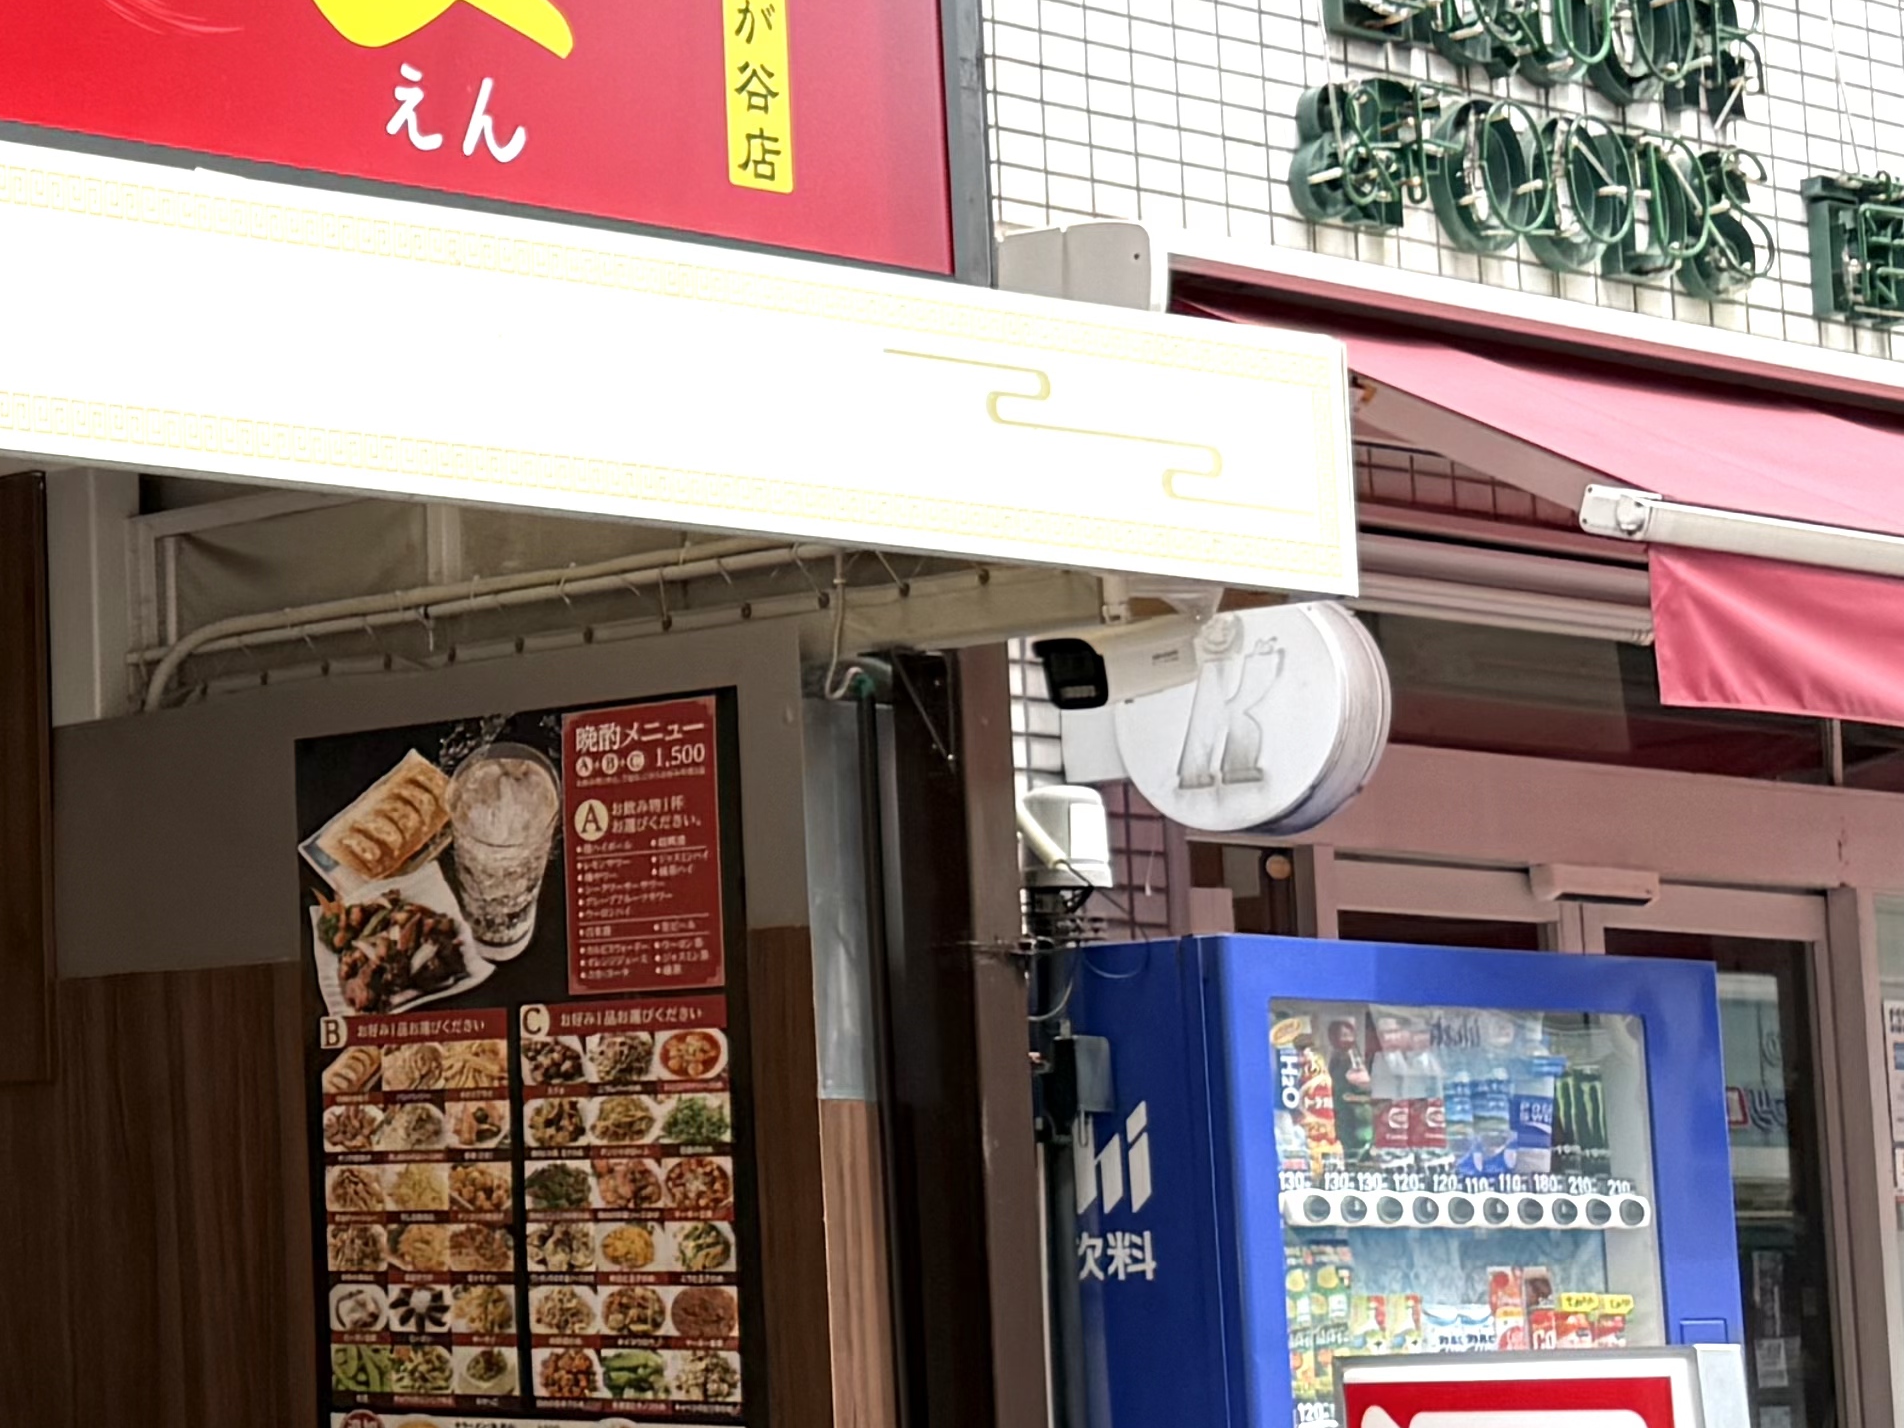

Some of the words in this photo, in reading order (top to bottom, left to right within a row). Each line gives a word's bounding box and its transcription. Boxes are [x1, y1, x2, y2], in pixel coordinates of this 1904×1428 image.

[386, 62, 528, 164] えん
[575, 722, 705, 753] 晩酌メニュー
